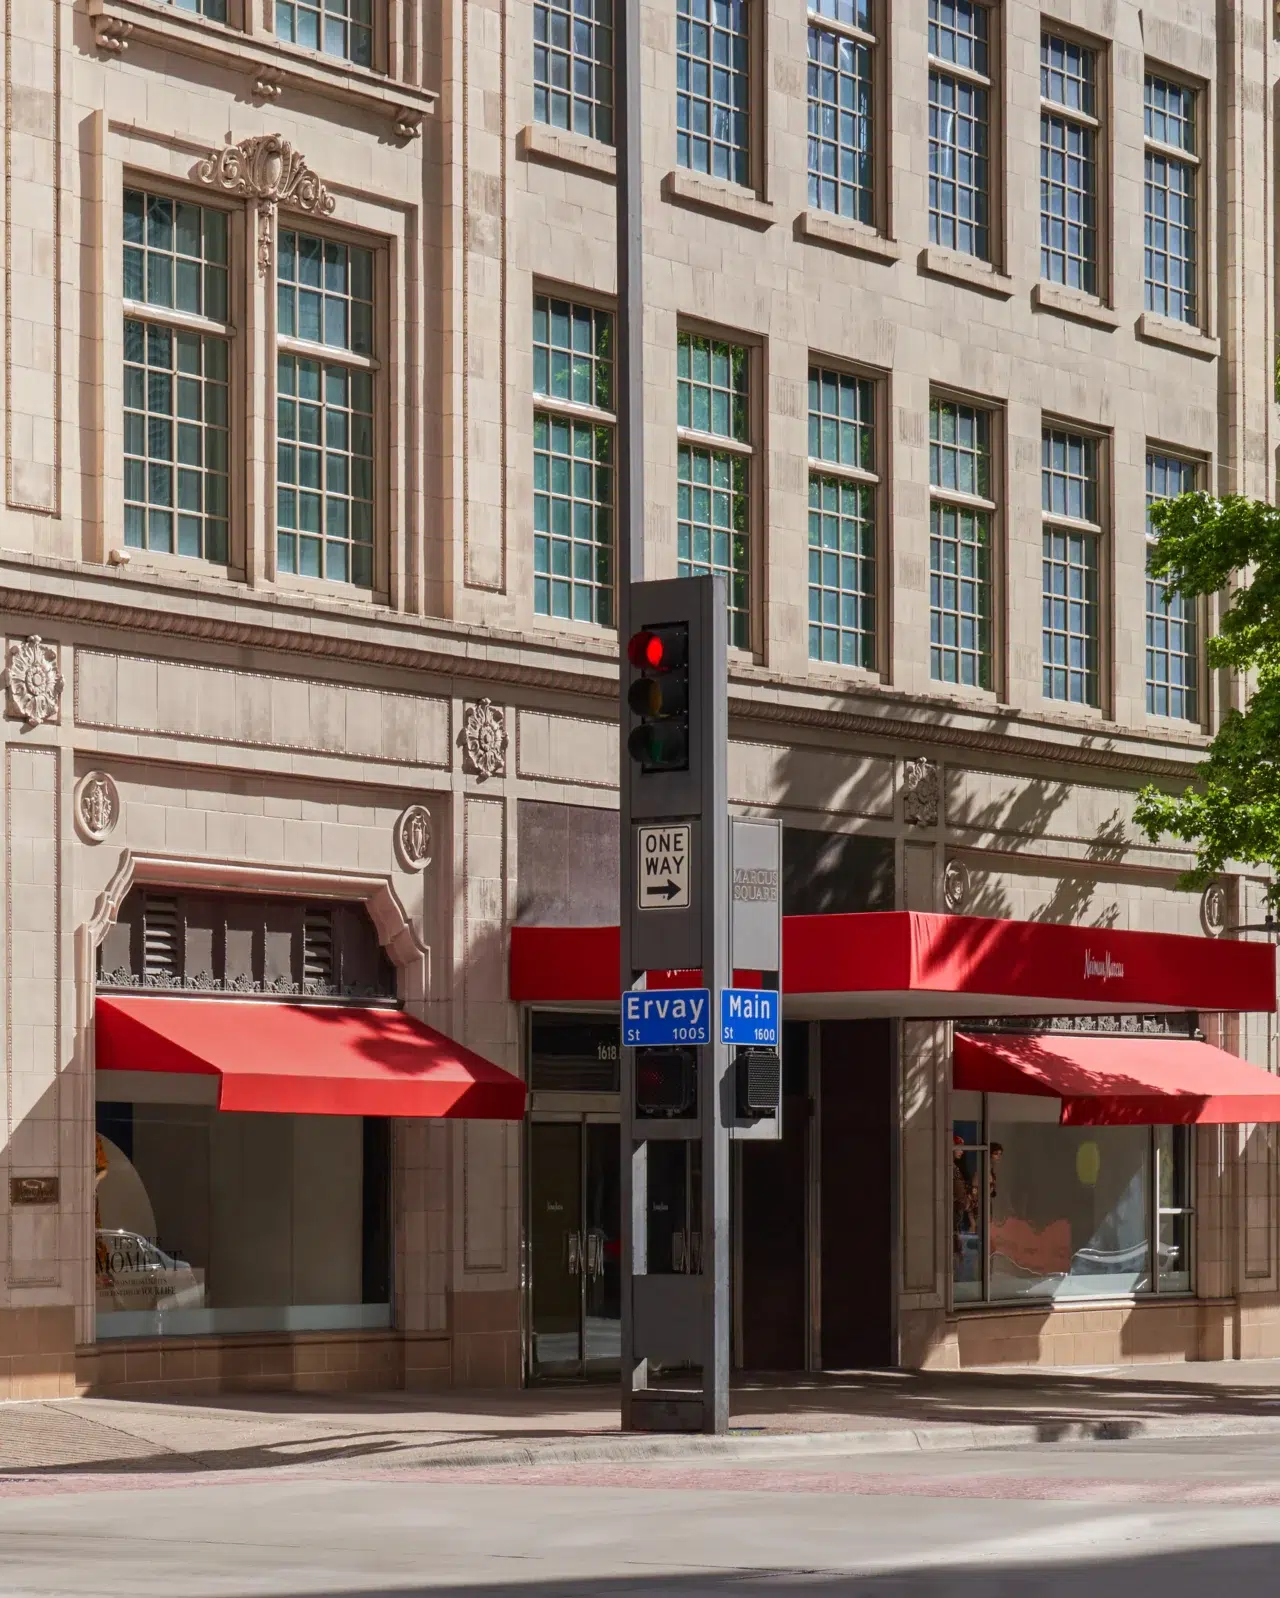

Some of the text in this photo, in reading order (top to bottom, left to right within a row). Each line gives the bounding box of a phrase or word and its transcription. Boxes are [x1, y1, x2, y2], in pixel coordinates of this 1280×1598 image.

[645, 833, 684, 853] ONE
[645, 856, 685, 876] WAY
[732, 869, 779, 885] MARCUS
[733, 885, 778, 901] SQUARE
[627, 996, 705, 1025] Ervay
[729, 993, 771, 1019] Main
[627, 1027, 706, 1042] St 100S
[724, 1026, 776, 1041] St 1600
[597, 1045, 617, 1060] 1618
[95, 1249, 183, 1275] MOMENT
